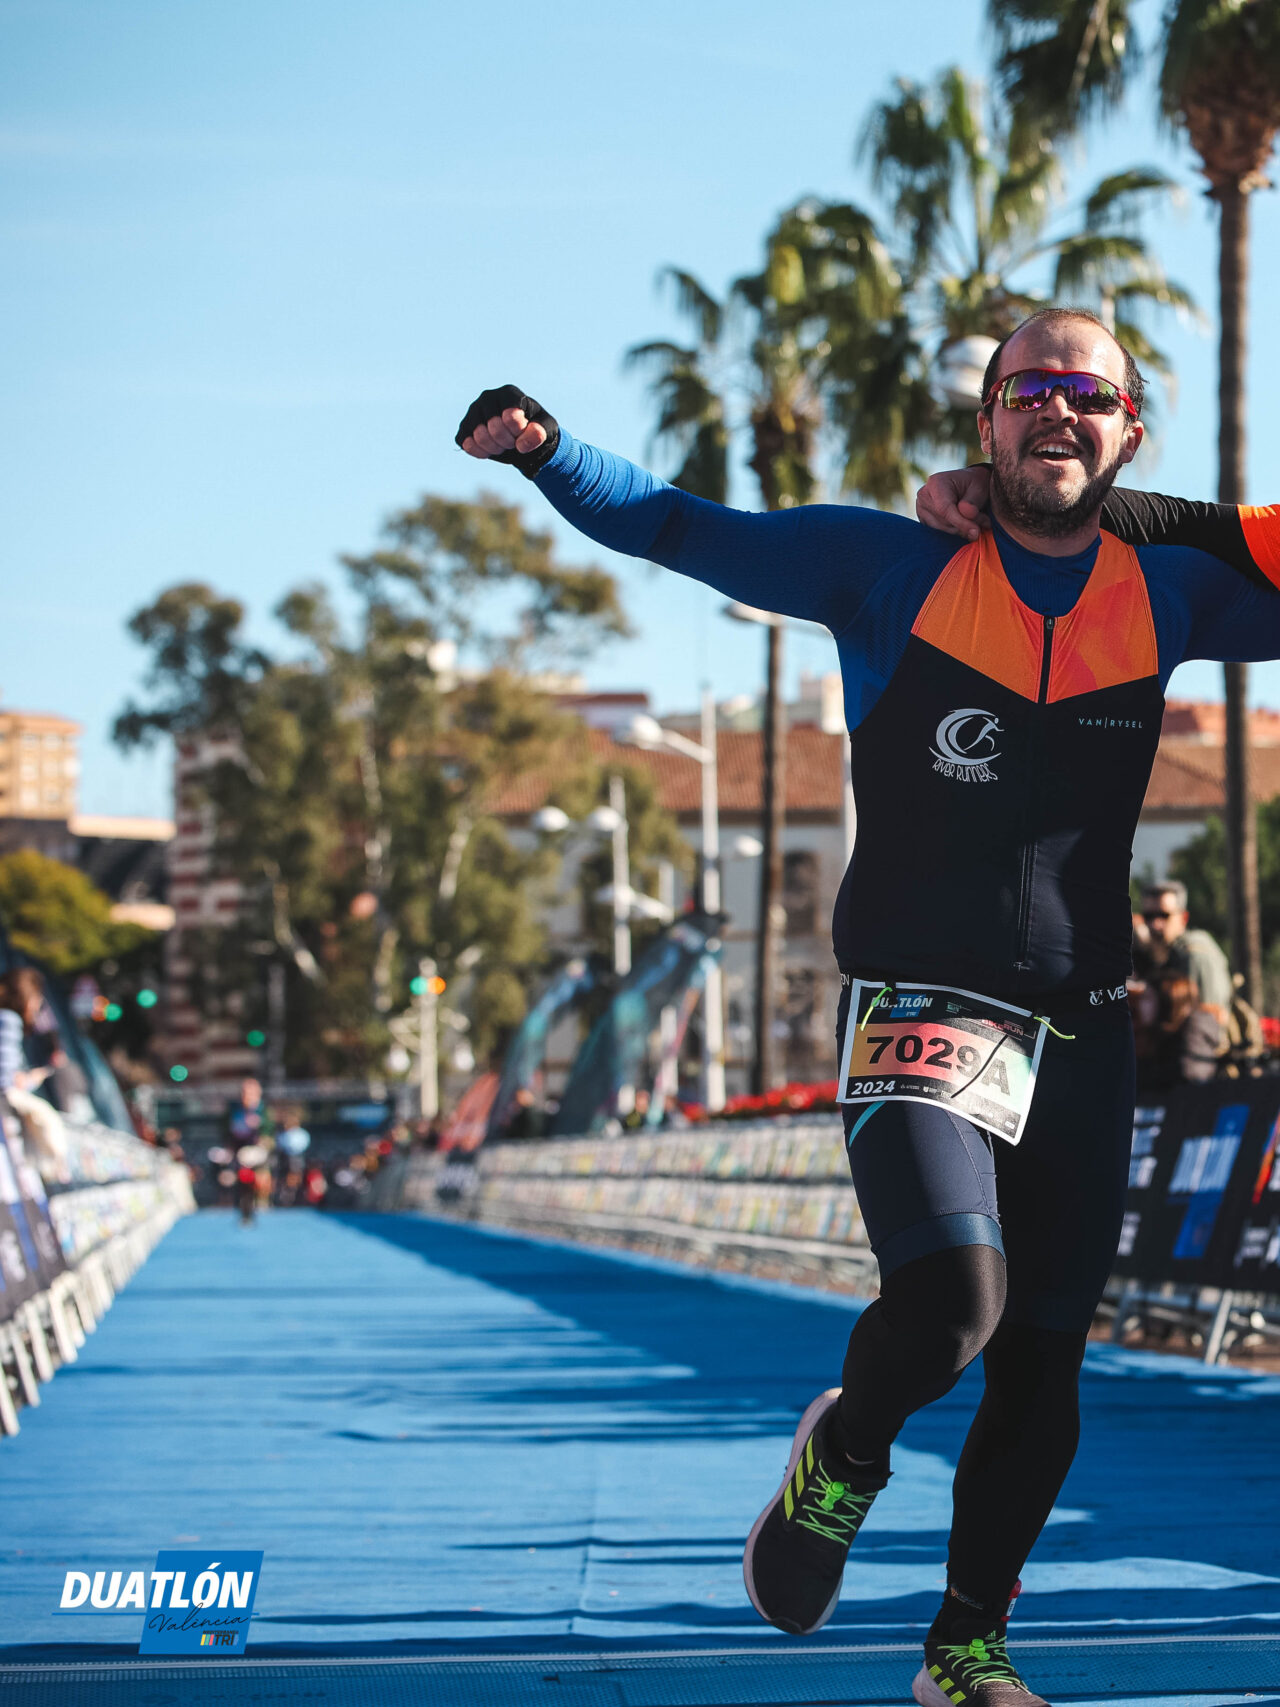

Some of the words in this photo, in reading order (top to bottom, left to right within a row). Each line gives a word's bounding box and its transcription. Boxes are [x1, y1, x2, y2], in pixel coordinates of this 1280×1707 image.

[1110, 719, 1143, 729] RYSEL
[871, 995, 933, 1008] DUTLÓN
[866, 1034, 1011, 1097] 7029A
[851, 1080, 896, 1095] 2024
